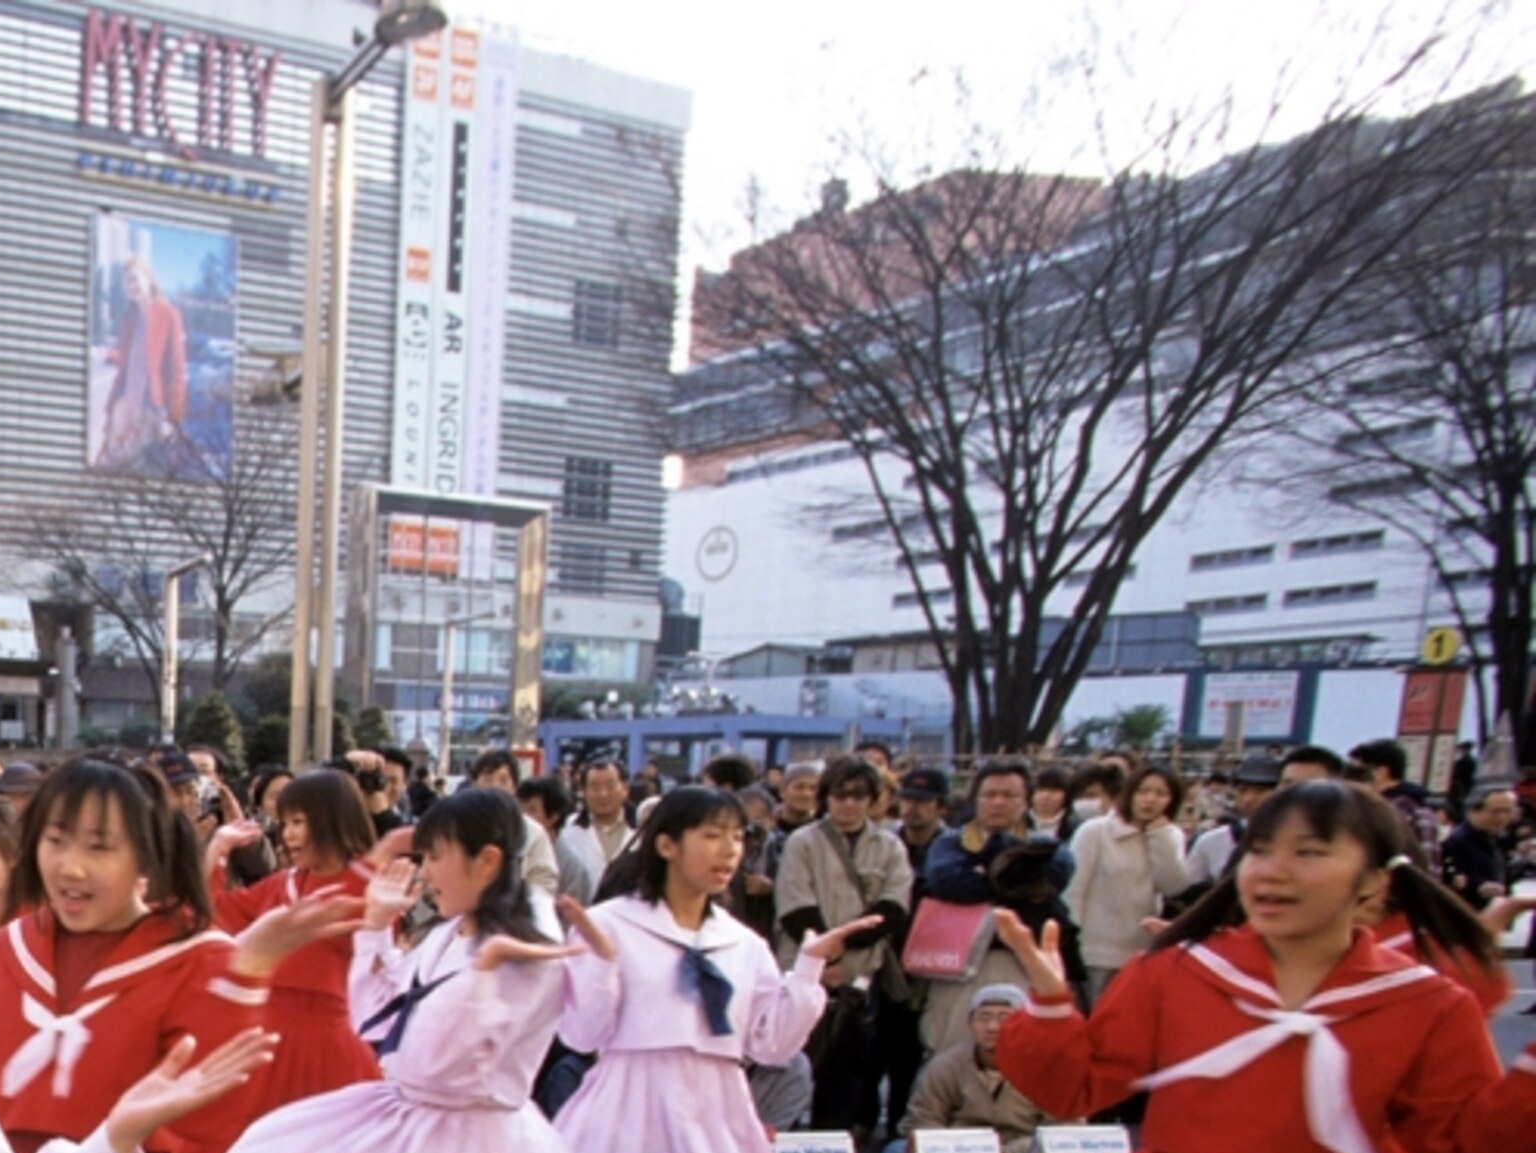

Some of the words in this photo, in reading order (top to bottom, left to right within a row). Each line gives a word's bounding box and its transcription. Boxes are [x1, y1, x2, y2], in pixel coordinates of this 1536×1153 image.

[77, 8, 163, 135] MY
[157, 31, 282, 161] CITY
[409, 123, 434, 219] ZAZIE
[443, 311, 463, 354] AR
[434, 382, 460, 495] INGRID
